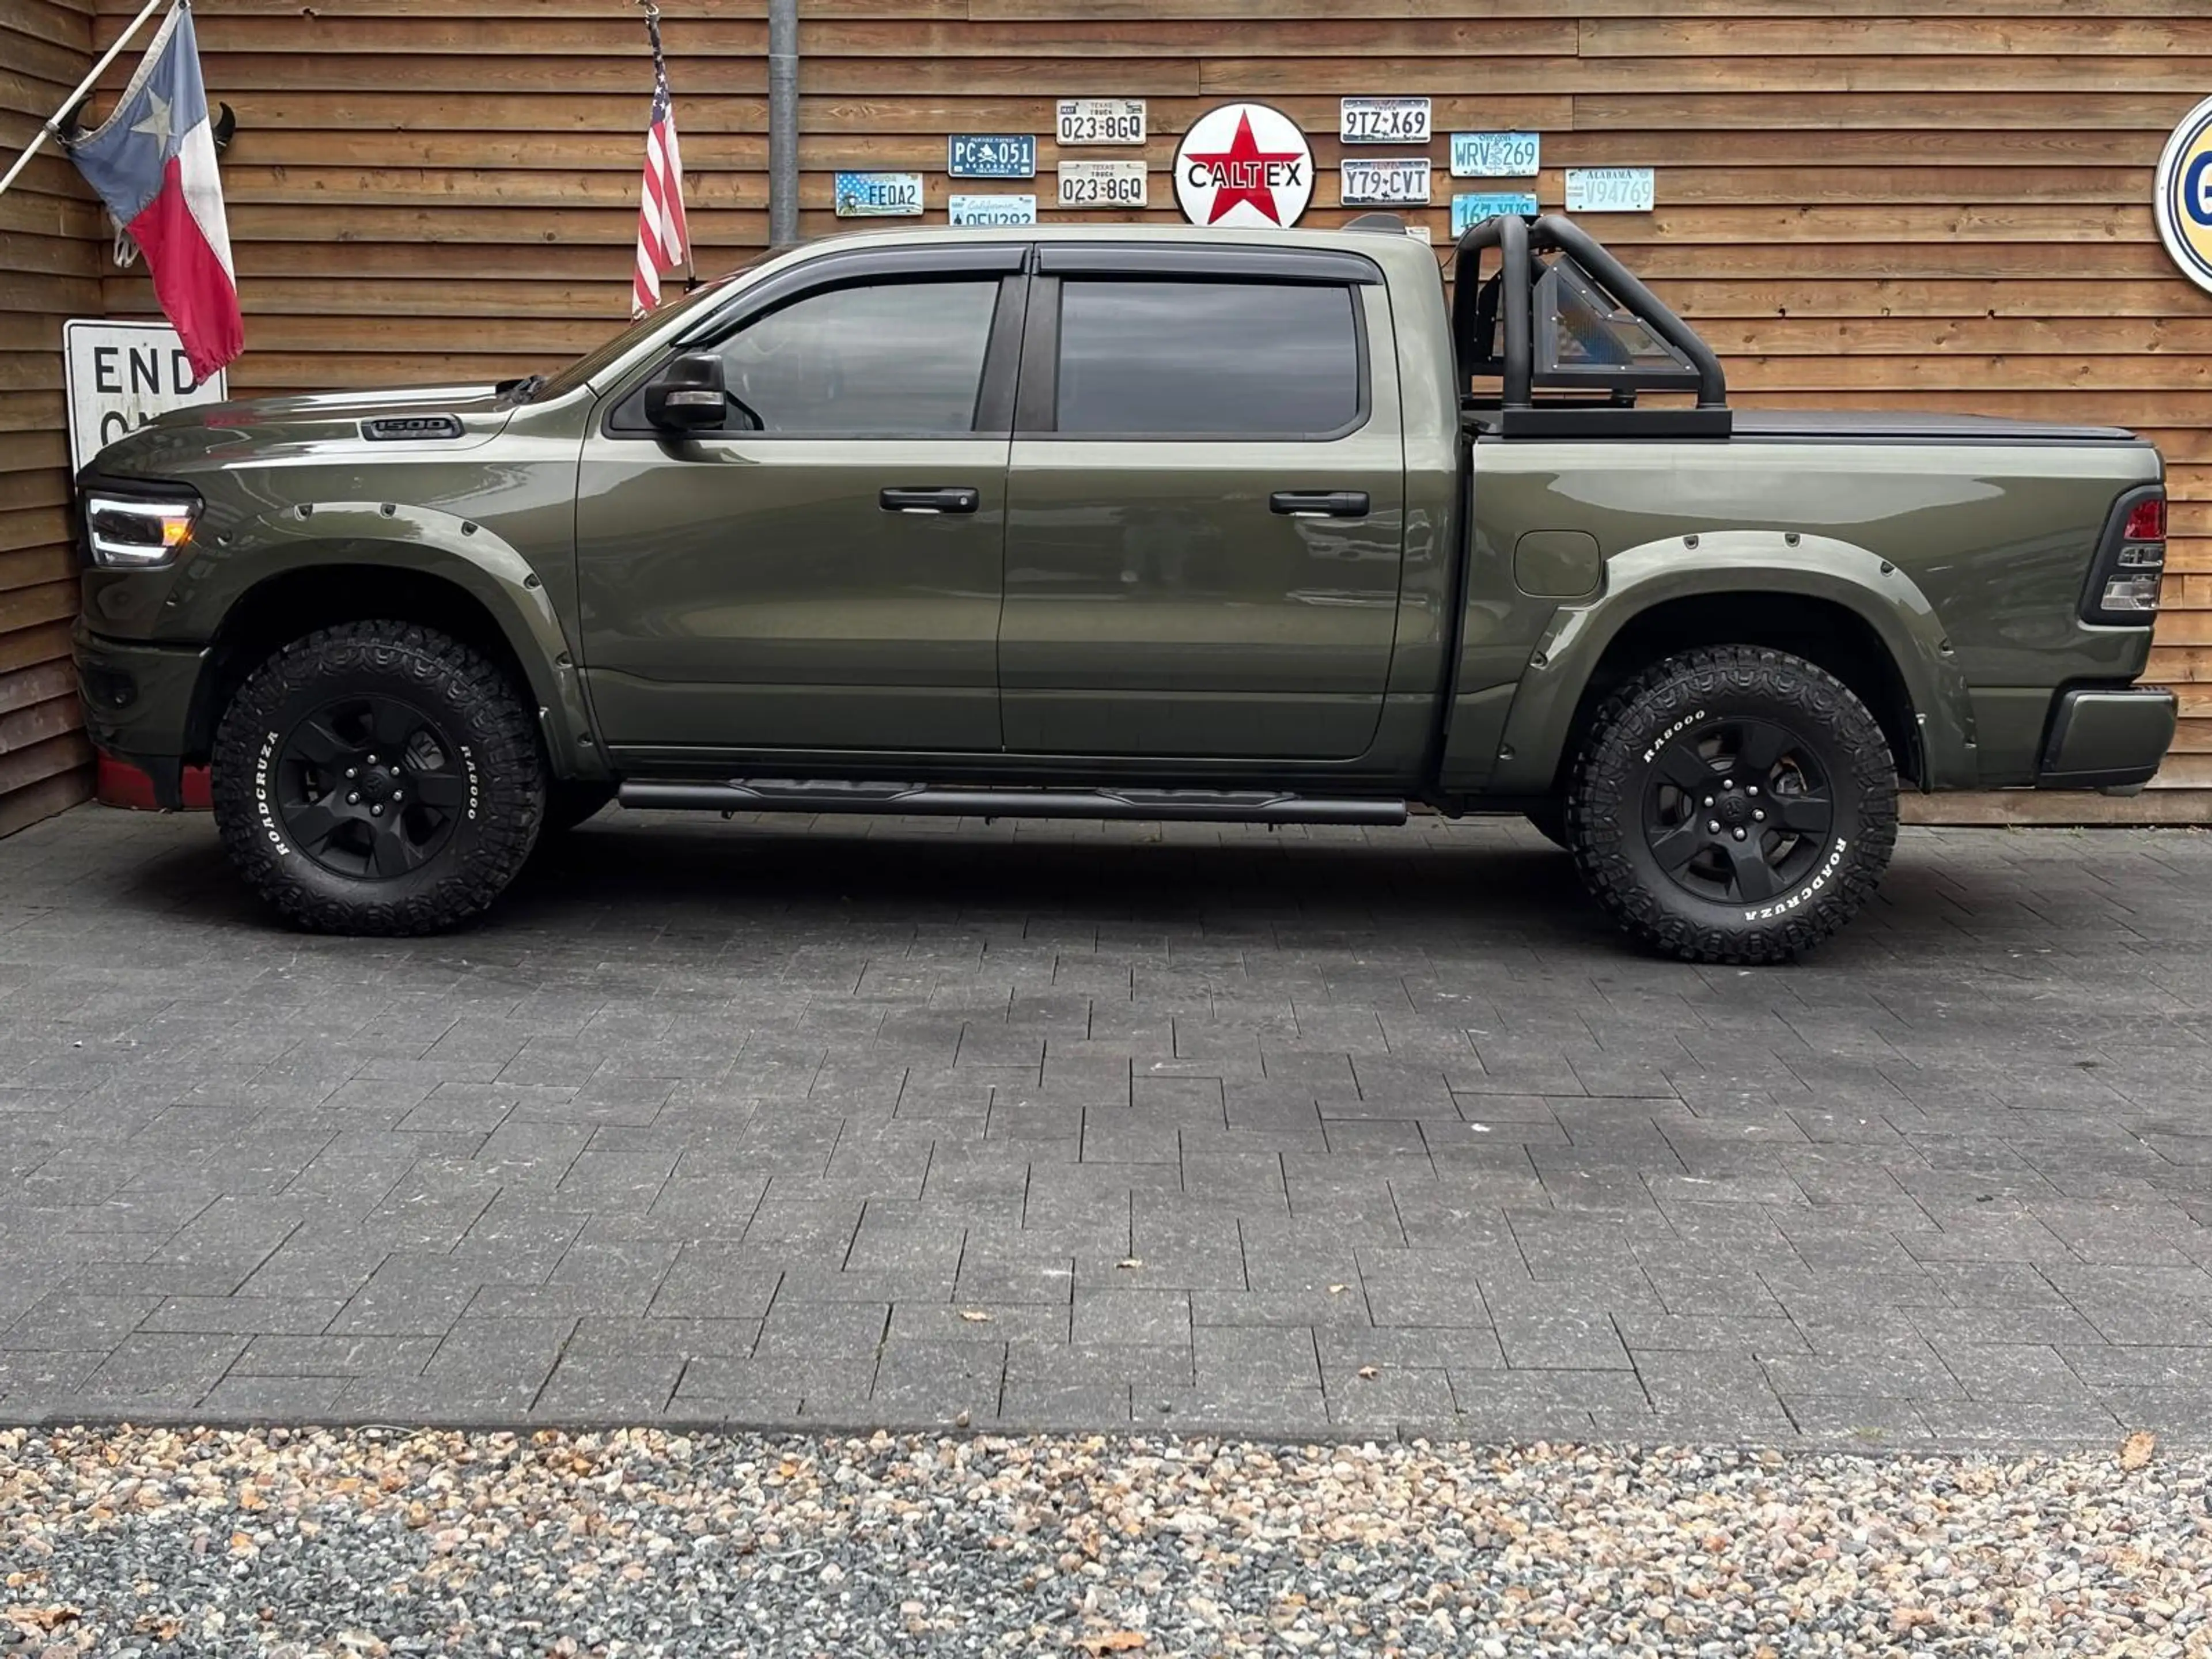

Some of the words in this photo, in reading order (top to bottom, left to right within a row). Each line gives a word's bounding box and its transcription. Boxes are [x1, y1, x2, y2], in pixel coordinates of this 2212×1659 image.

[1062, 117, 1097, 139] 023
[1347, 112, 1381, 134] 9TZ
[1391, 111, 1425, 134] X69
[955, 142, 976, 162] PC
[999, 143, 1030, 164] 051
[1455, 142, 1490, 166] WRV
[1503, 142, 1535, 165] 269
[1188, 162, 1302, 188] CALTEX
[1346, 171, 1381, 194] Y79
[1390, 171, 1426, 193] CVT
[1586, 169, 1633, 179] ALABAMA
[1063, 179, 1097, 200] 023
[1585, 180, 1651, 203] V94769
[375, 419, 447, 432] 1500
[255, 730, 291, 855] ROADCRUZA
[1744, 836, 1847, 921] ROADCRUZA
